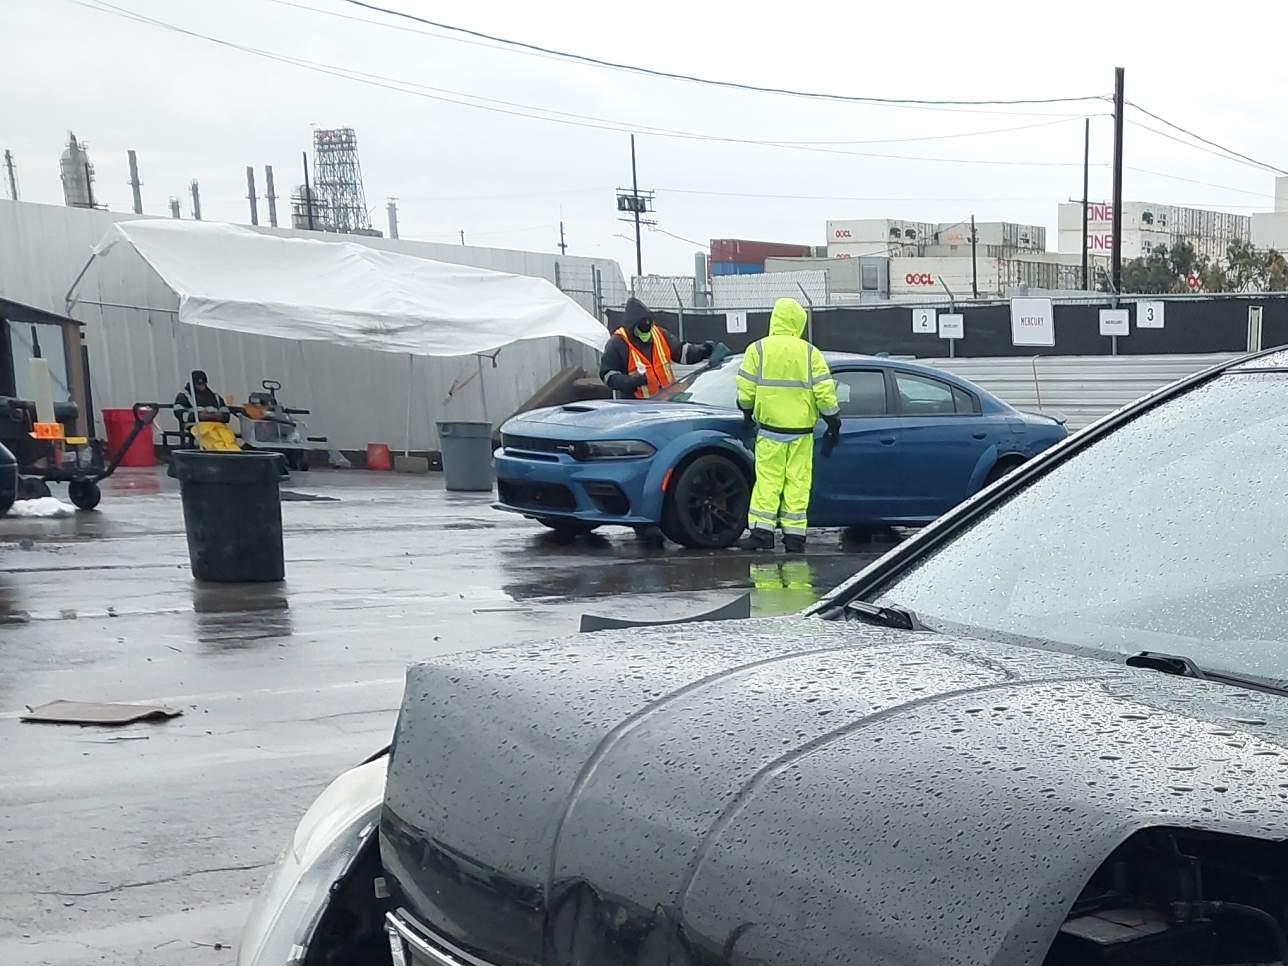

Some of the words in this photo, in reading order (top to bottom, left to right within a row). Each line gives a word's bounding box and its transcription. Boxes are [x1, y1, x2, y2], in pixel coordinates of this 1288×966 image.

[905, 273, 934, 285] OOCL
[1147, 307, 1154, 321] 3
[921, 314, 928, 327] 2
[1020, 316, 1044, 326] MERCURY
